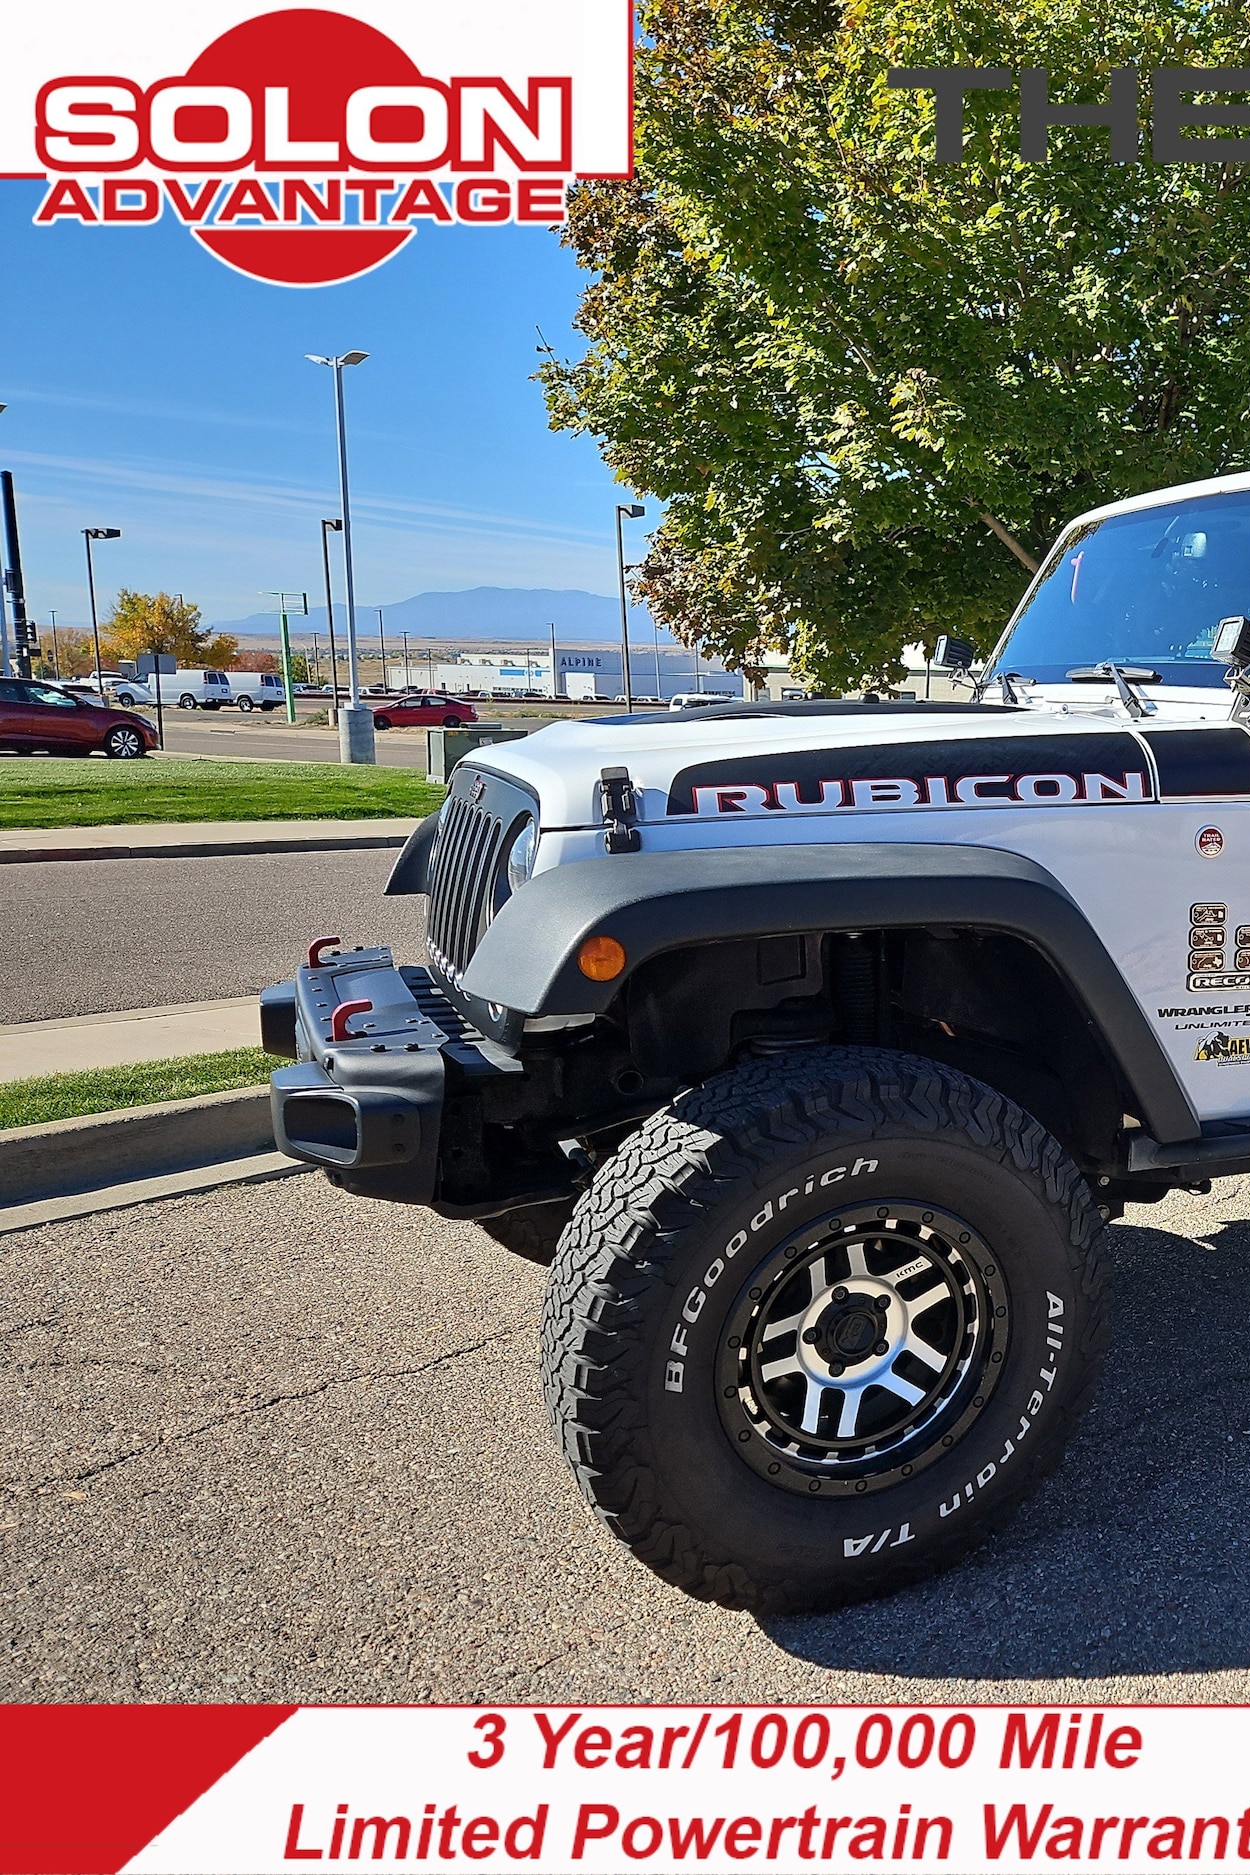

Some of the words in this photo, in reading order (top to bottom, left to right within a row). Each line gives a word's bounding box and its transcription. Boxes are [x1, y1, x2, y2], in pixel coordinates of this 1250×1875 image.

[560, 656, 602, 667] ALPINE
[692, 772, 1153, 815] RUBICON
[664, 1157, 879, 1393] BFGoodrich
[938, 1290, 1065, 1518] All-Terrain
[843, 1522, 916, 1558] T/A
